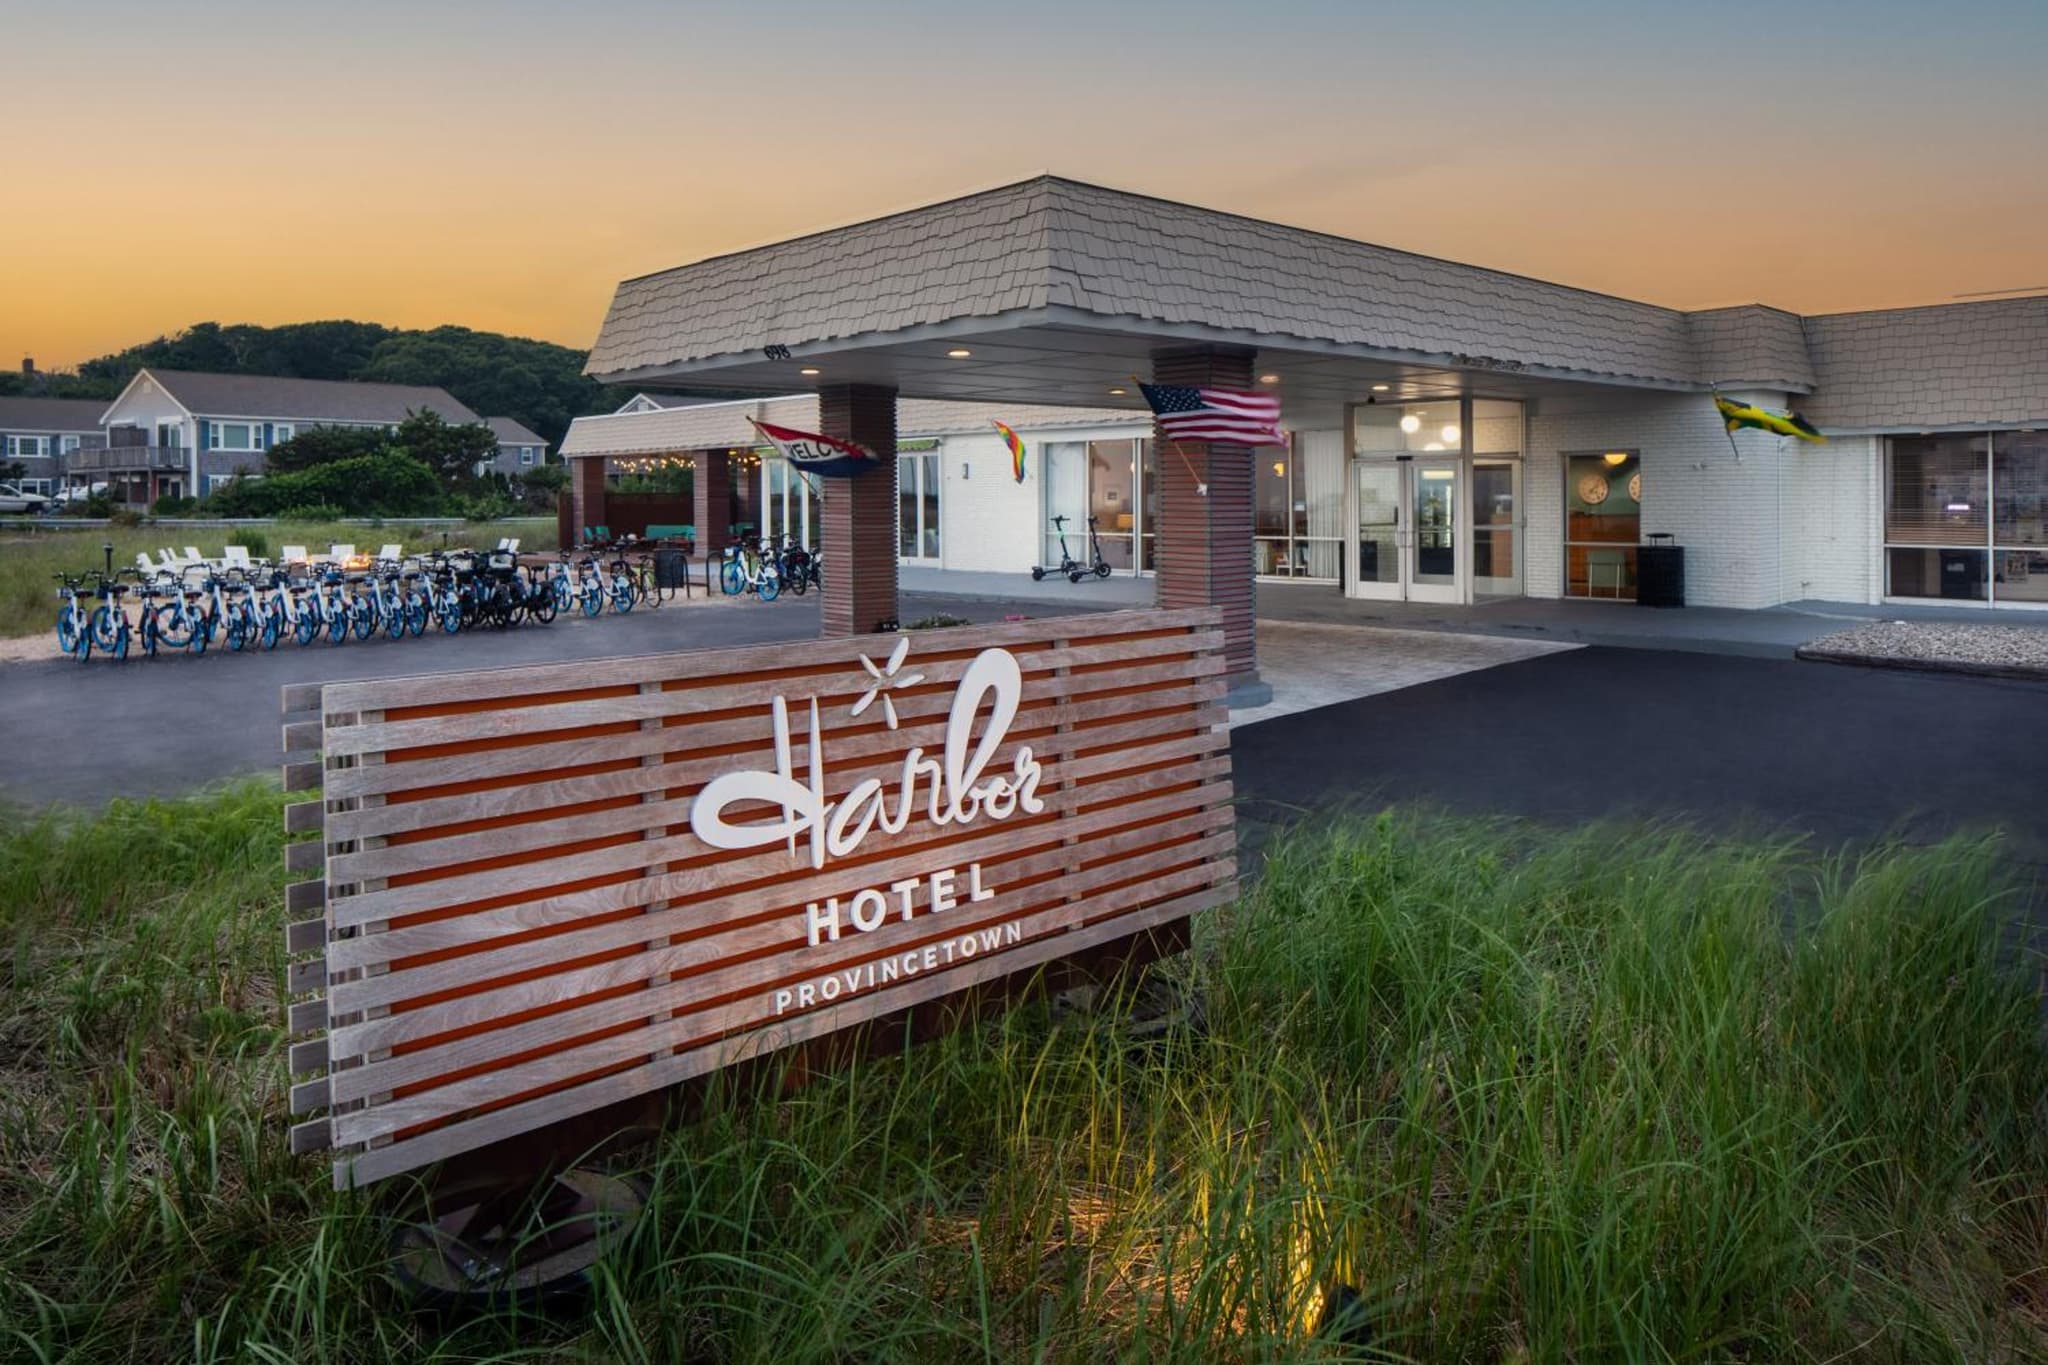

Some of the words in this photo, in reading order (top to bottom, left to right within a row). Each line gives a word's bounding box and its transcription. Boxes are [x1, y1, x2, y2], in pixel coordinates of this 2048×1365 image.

[764, 344, 791, 360] 698
[691, 648, 1044, 869] Harbor
[807, 864, 995, 947] HOTEL
[776, 922, 1021, 1014] PROVINCETOWN
